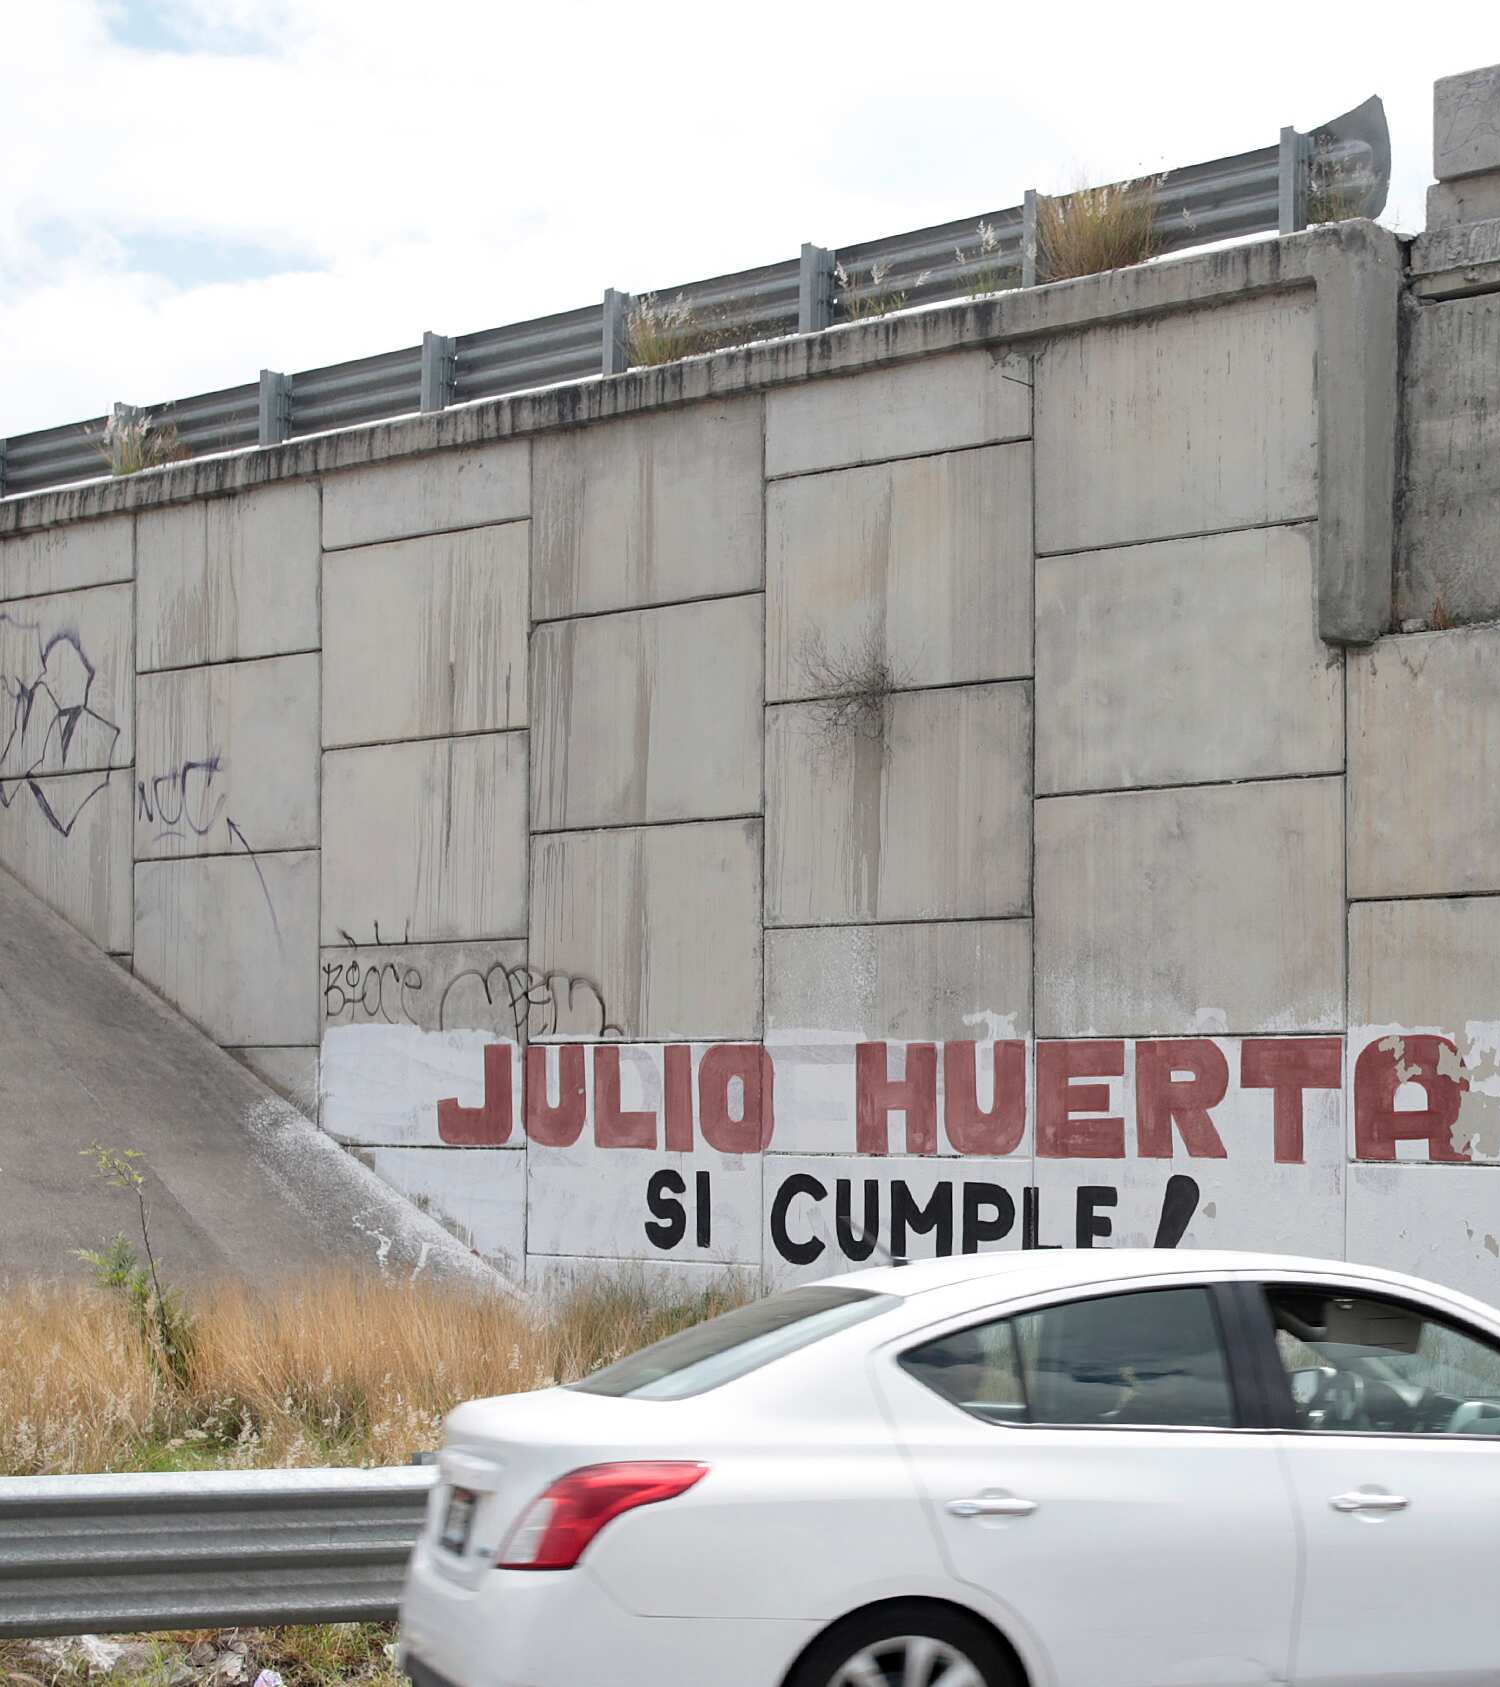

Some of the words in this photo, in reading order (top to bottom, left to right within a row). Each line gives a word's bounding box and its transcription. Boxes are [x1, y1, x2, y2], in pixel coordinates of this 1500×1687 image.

[437, 1043, 775, 1154] JULIO
[856, 1035, 1472, 1165] HUERTA
[644, 1169, 711, 1250] SI
